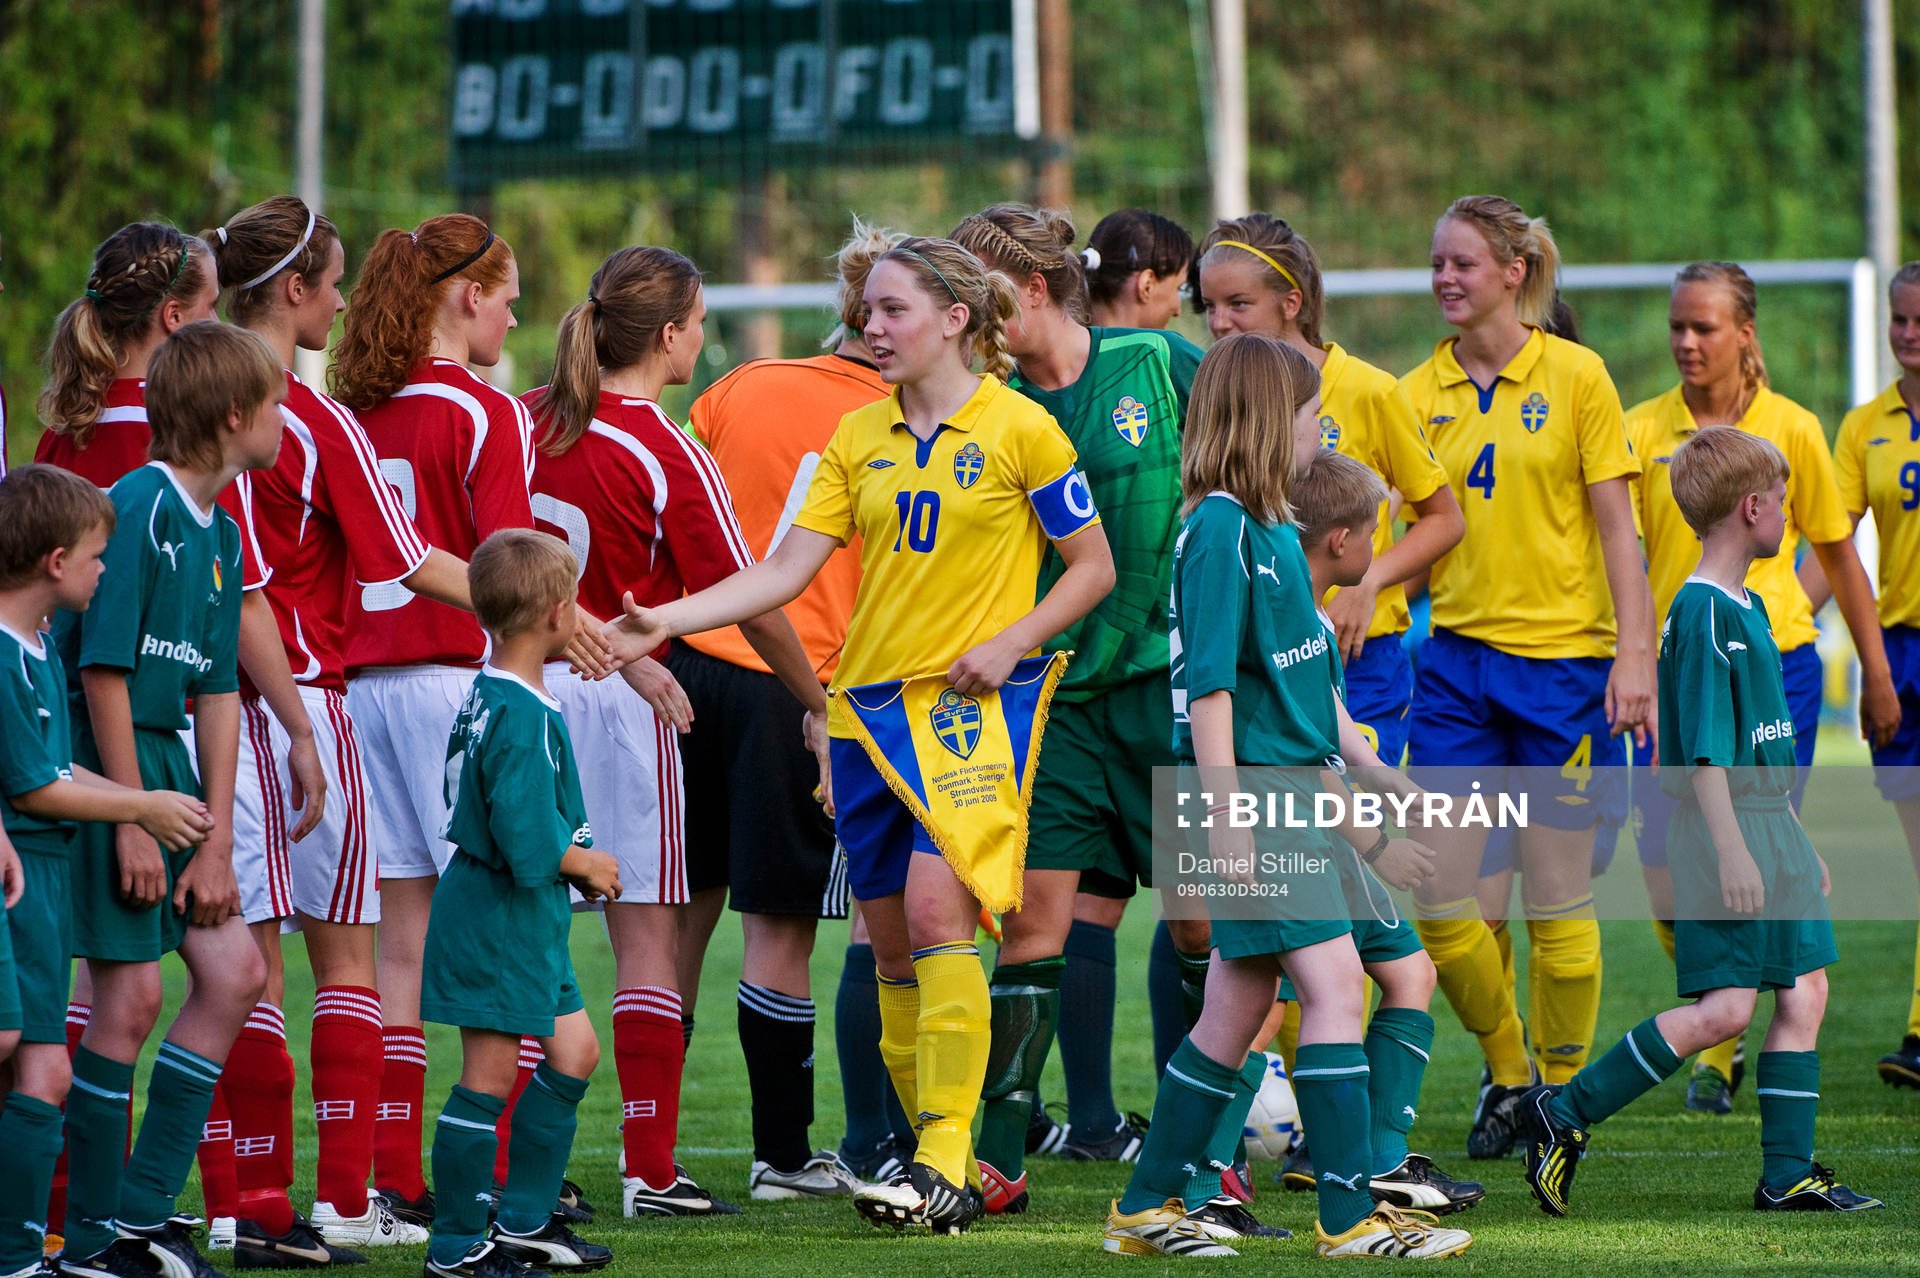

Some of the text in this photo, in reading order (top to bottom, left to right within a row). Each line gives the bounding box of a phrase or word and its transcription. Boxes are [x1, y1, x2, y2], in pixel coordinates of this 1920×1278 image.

[1466, 443, 1496, 499] 4
[1063, 474, 1094, 518] C
[893, 490, 941, 553] 10
[932, 763, 1007, 784] Nordisk Flickturnering
[1561, 734, 1592, 792] 4
[938, 777, 971, 792] Danmark
[978, 773, 1005, 782] Sverige
[950, 785, 996, 798] Strandvallen
[954, 798, 963, 808] 30
[965, 797, 979, 807] juni
